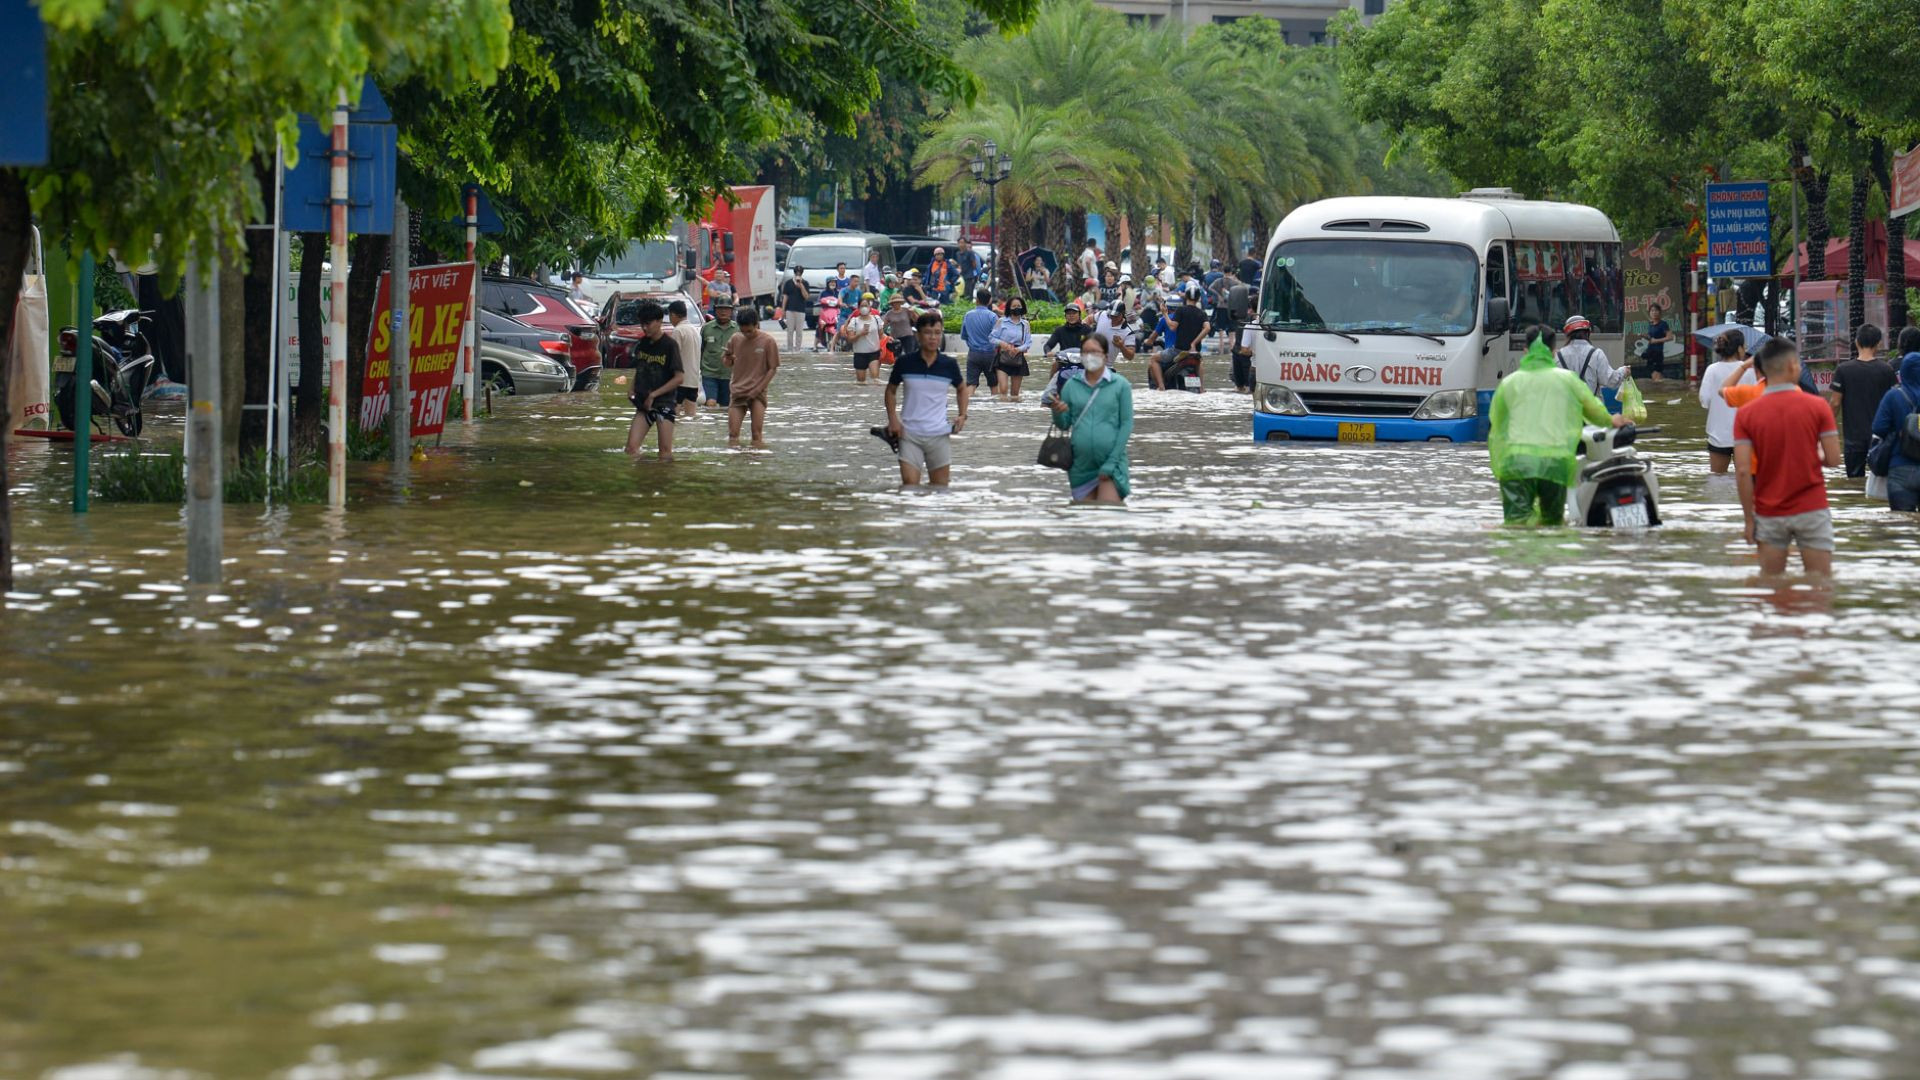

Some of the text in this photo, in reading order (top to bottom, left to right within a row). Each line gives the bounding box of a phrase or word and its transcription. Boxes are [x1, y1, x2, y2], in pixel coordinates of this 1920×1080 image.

[1744, 208, 1766, 218] KHOA
[1711, 236, 1767, 256] NHÀ THUỐC
[1714, 258, 1767, 273] ĐỨC TÂM
[432, 270, 459, 291] VIỆT
[428, 302, 464, 347] XE
[415, 349, 455, 375] NGHIỆP
[1280, 357, 1443, 385] HOÀNG CHINH
[417, 386, 448, 427] 15K
